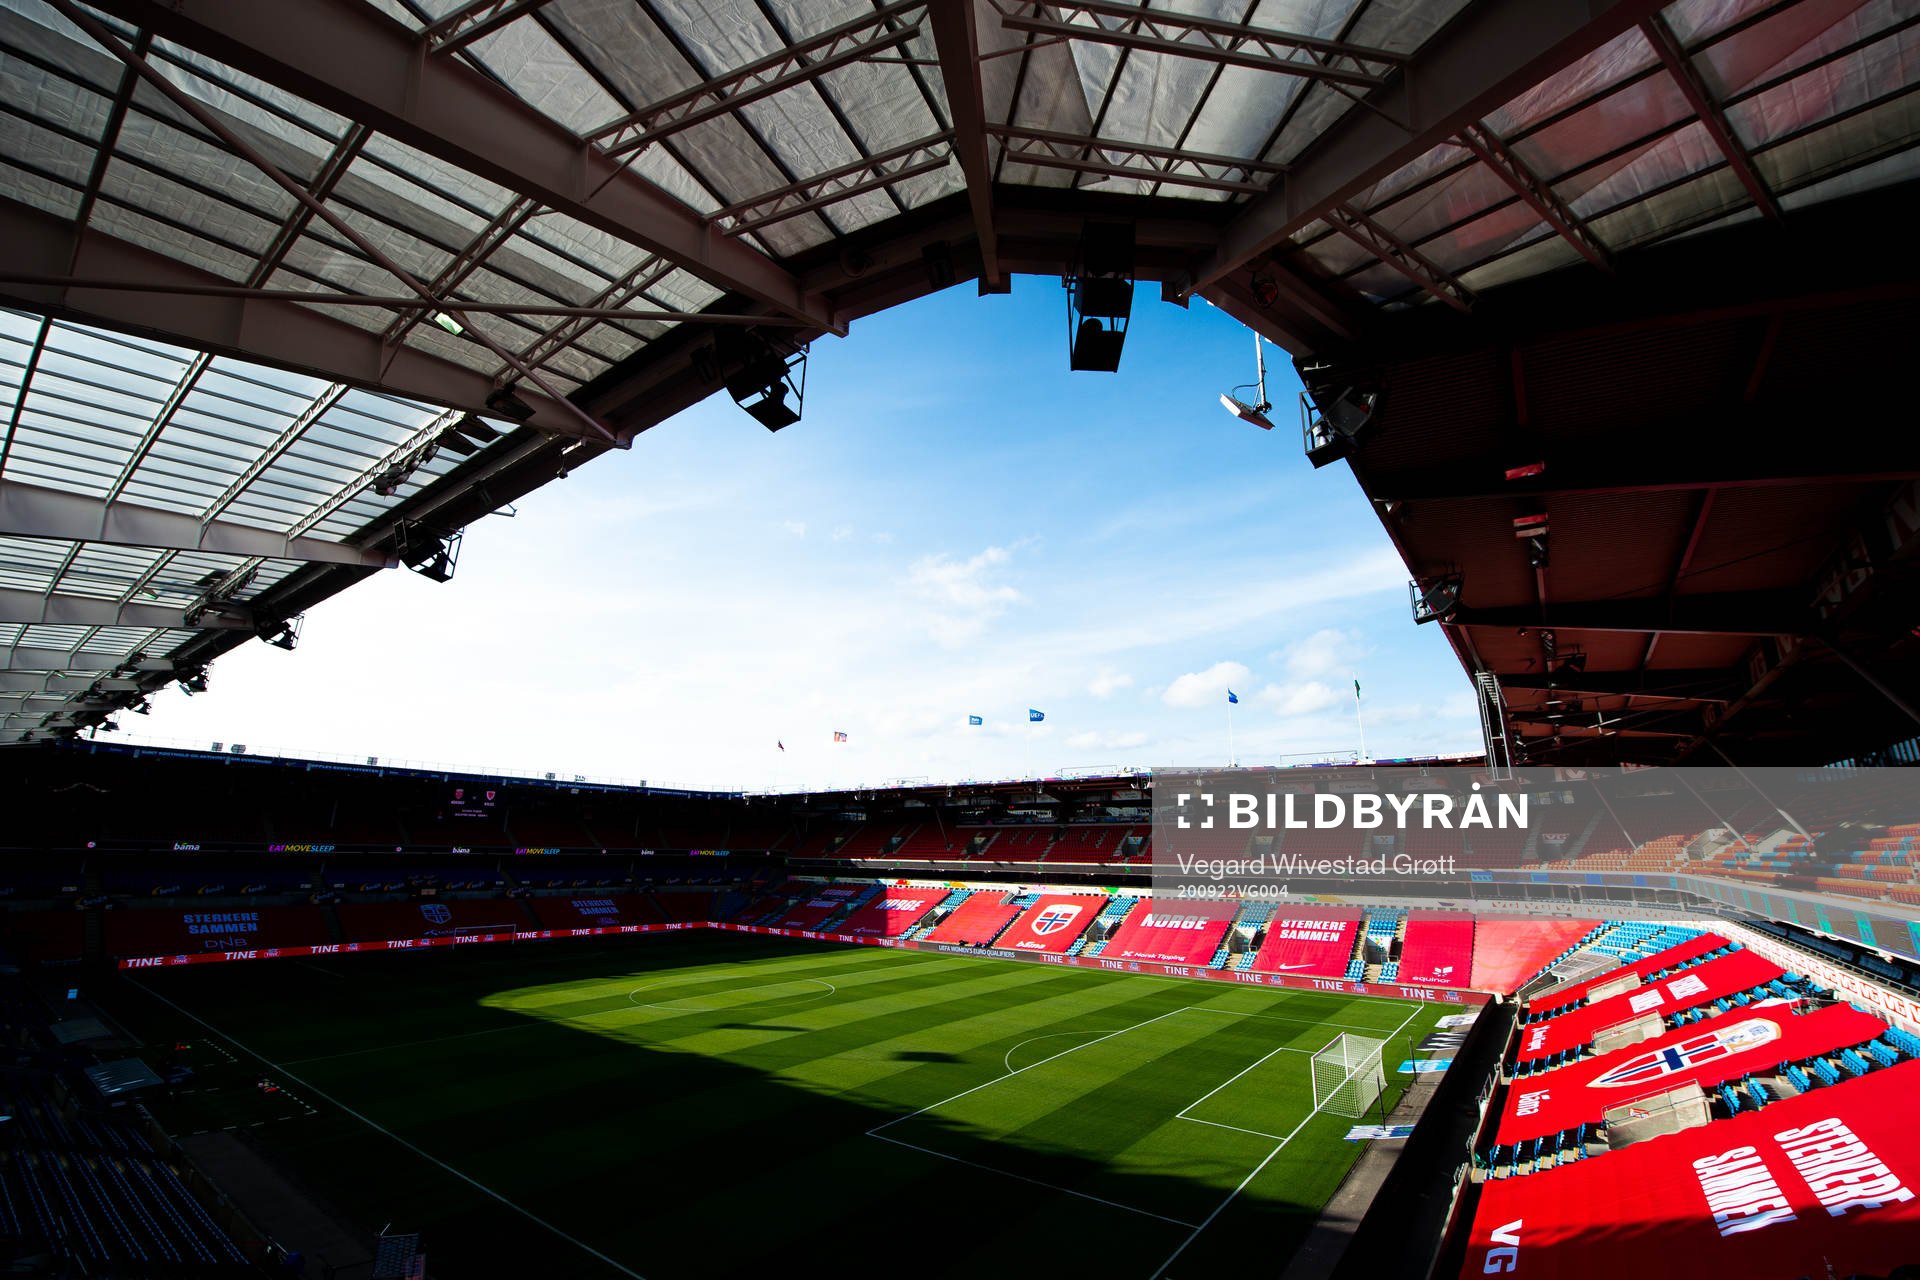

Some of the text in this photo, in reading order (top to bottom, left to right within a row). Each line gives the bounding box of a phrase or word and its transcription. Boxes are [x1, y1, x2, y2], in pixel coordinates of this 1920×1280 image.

[183, 912, 259, 923] STERKERE
[1140, 913, 1209, 930] NORGE
[189, 922, 258, 935] SAMMEN
[665, 922, 682, 930] TINE
[1281, 918, 1347, 931] STERKERE
[516, 931, 538, 939] TINE
[571, 928, 591, 936] TINE
[802, 930, 816, 938] TINE
[1279, 929, 1340, 942] SAMMEN
[387, 939, 414, 948] TINE
[455, 935, 479, 943] TINE
[878, 938, 893, 946] TINE
[310, 944, 340, 954] TINE
[951, 946, 973, 954] WOMEN'S
[986, 949, 1015, 958] QUALIFIERS
[225, 951, 258, 960] TINE
[1042, 954, 1063, 964] TINE
[127, 957, 164, 967] TINE
[1100, 960, 1123, 969] TINE
[1164, 965, 1189, 976] TINE
[1234, 972, 1263, 983] TINE
[1412, 976, 1451, 984] equinor
[1312, 979, 1344, 991] TINE
[1400, 987, 1435, 1000] TINE
[1774, 1118, 1916, 1217] STERKERE
[1692, 1146, 1798, 1237] SAMMEN
[1483, 1218, 1523, 1274] VG
